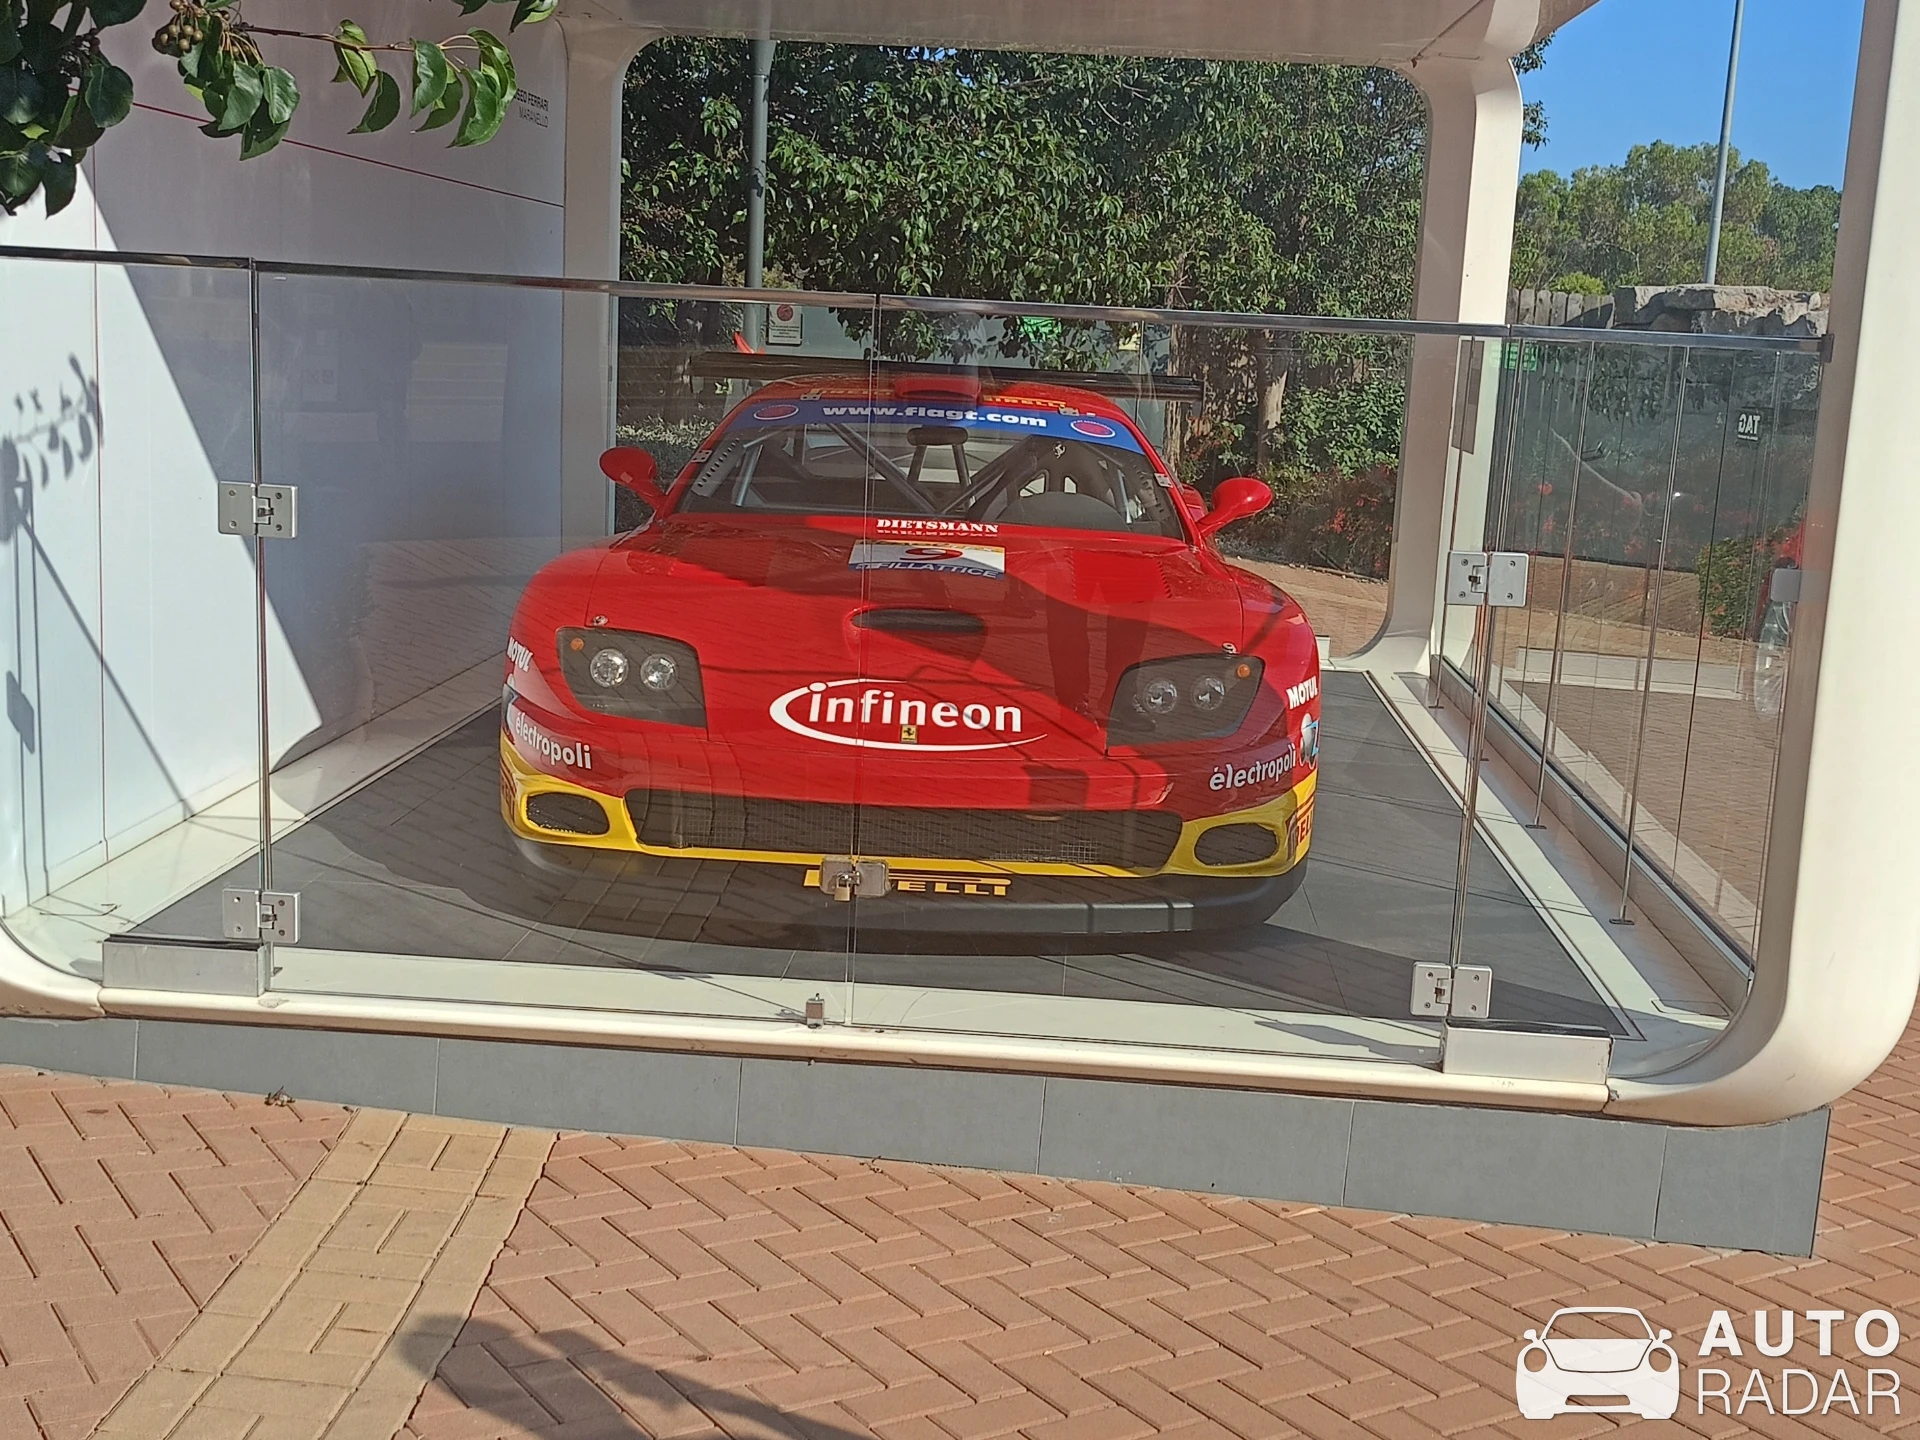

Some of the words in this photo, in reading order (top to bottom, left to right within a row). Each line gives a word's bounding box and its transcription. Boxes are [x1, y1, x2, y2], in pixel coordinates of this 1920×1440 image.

[528, 92, 549, 111] FERRARI
[876, 519, 999, 533] DIETSMANN
[899, 547, 964, 561] 9
[507, 636, 533, 672] MOTUL
[808, 681, 1022, 732] infineon
[1286, 675, 1318, 710] MOTUL
[515, 711, 592, 770] électropoli
[1209, 742, 1296, 791] électropoli
